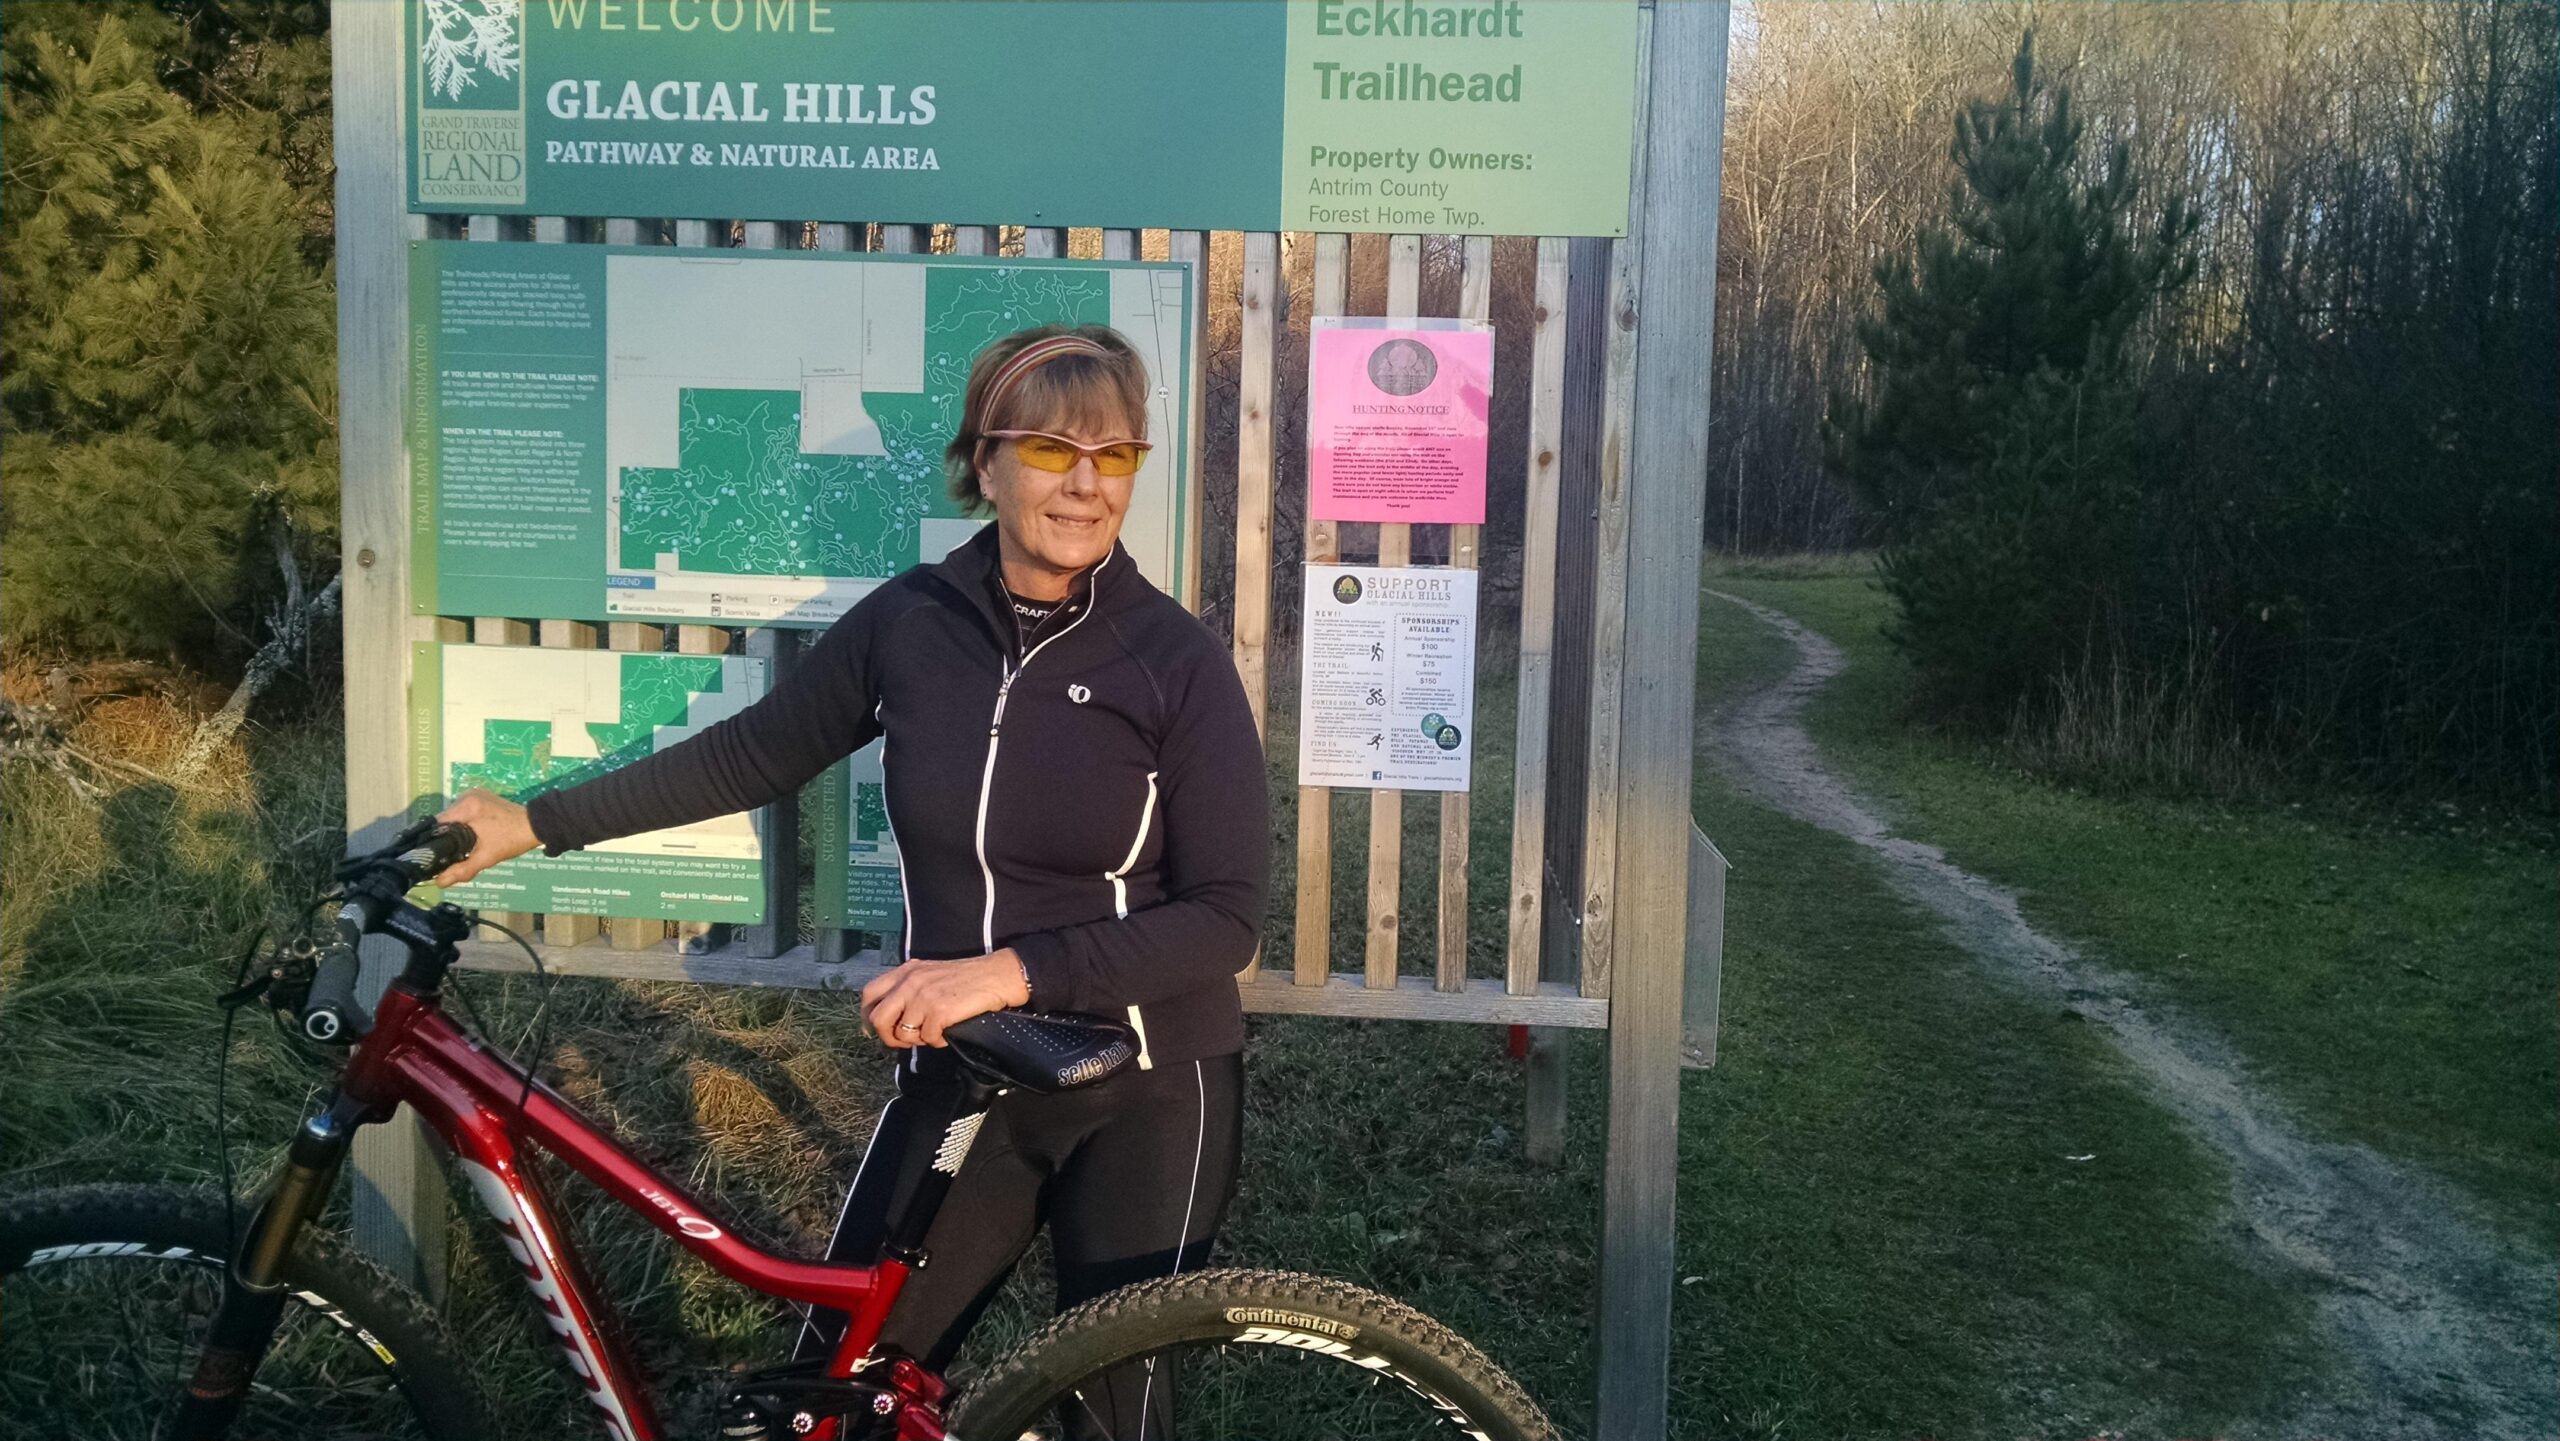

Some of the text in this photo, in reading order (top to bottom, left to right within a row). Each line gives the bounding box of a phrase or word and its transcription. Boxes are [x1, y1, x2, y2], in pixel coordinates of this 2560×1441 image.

[548, 0, 835, 33] WELCOME
[1316, 0, 1524, 38] Eckhardt
[1313, 62, 1522, 102] Trailhead
[546, 79, 937, 126] GLACIAL HILLS
[421, 116, 521, 130] GRAND TRAVERSE
[423, 130, 521, 152] REGIONAL
[423, 152, 521, 182] LAND
[546, 141, 940, 171] PATHWAY & NATURAL AREA
[1310, 145, 1533, 173] Property Owners:
[421, 184, 522, 197] CONSERVANCY
[1309, 177, 1449, 201] Antrim County
[1309, 205, 1485, 229] Forest Home Twp.
[1353, 404, 1450, 415] HUNTING NOTICE
[416, 323, 430, 535] TRAIL MAP & INFORMATION
[607, 578, 640, 586] LEGEND
[1367, 577, 1452, 591] SUPPORT
[1367, 590, 1451, 601] GLACIAL HILLS
[1014, 604, 1051, 618] CRAFT
[1402, 617, 1460, 625] SPONSORSHIPS
[823, 773, 836, 862] SUGGESTED
[1058, 1057, 1103, 1086] selle
[1226, 1307, 1339, 1336] Continental
